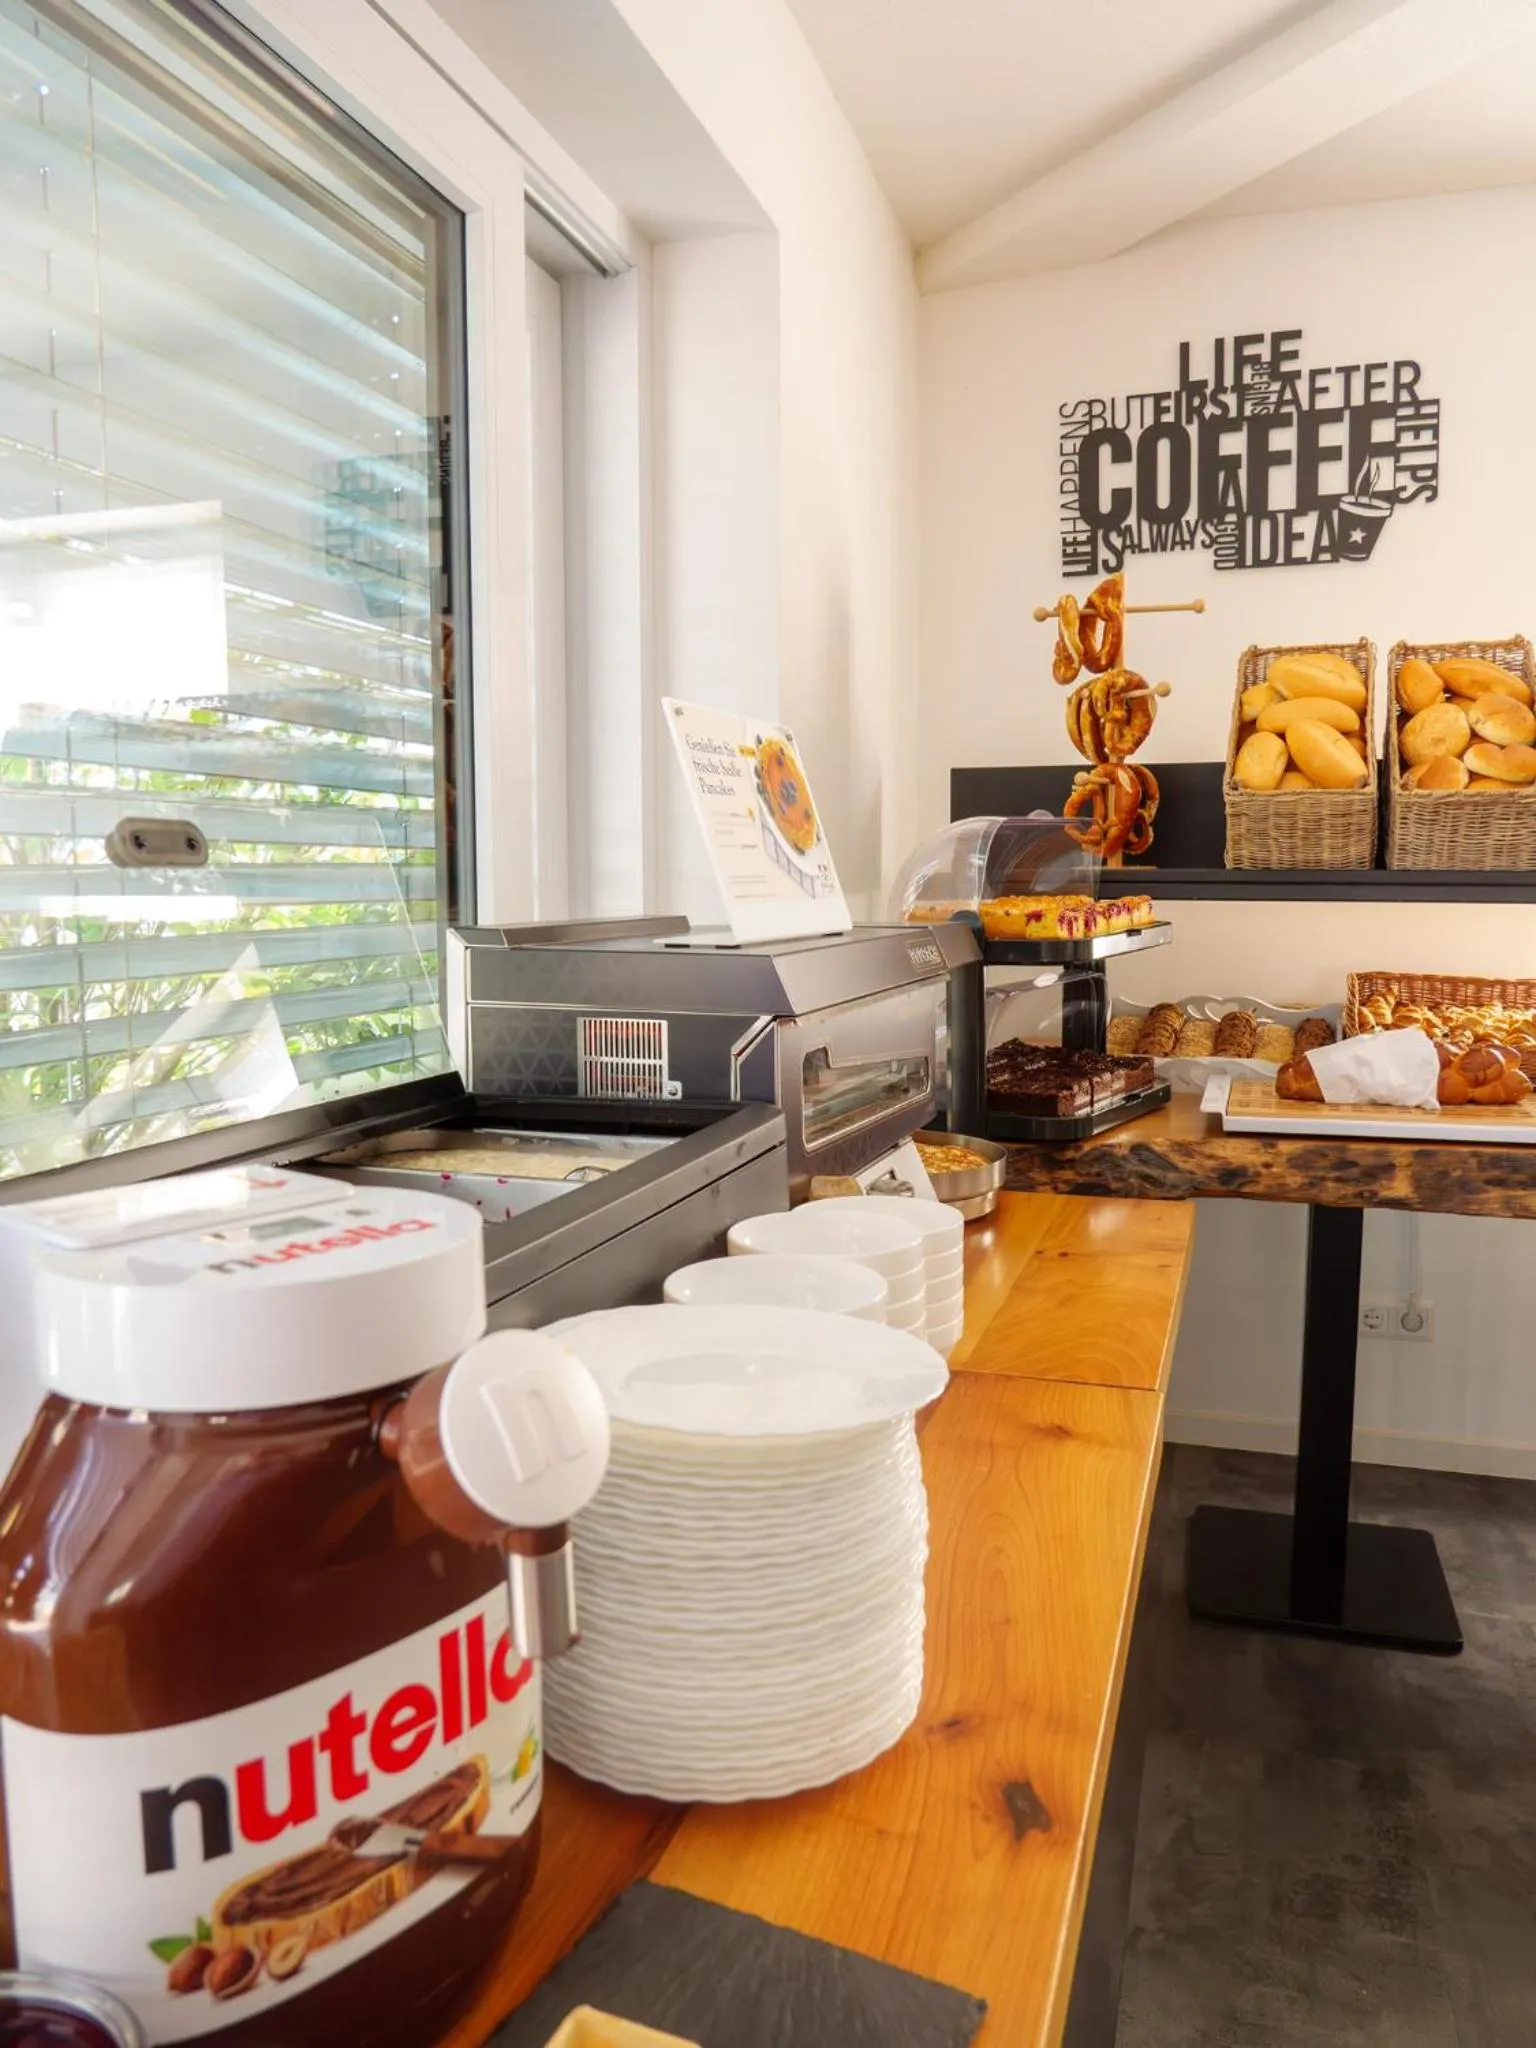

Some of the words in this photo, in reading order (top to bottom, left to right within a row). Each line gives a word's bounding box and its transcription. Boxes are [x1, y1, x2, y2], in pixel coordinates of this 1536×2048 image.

[1179, 329, 1303, 391] LIFE
[1273, 361, 1421, 414] AFTER
[1087, 394, 1153, 431] BUT
[1154, 384, 1251, 424] FIRST
[1250, 361, 1274, 416] BEGINS
[1060, 400, 1090, 534] HAPPENS
[1079, 402, 1396, 528] COFFEE
[1394, 399, 1439, 504] HELPS
[1062, 532, 1092, 577] LIFE
[1120, 519, 1215, 555] ALWAYS
[1213, 522, 1239, 571] GOOD
[1238, 508, 1341, 568] IDEA
[206, 1219, 437, 1275] nutella
[139, 1613, 534, 1875] nutella
